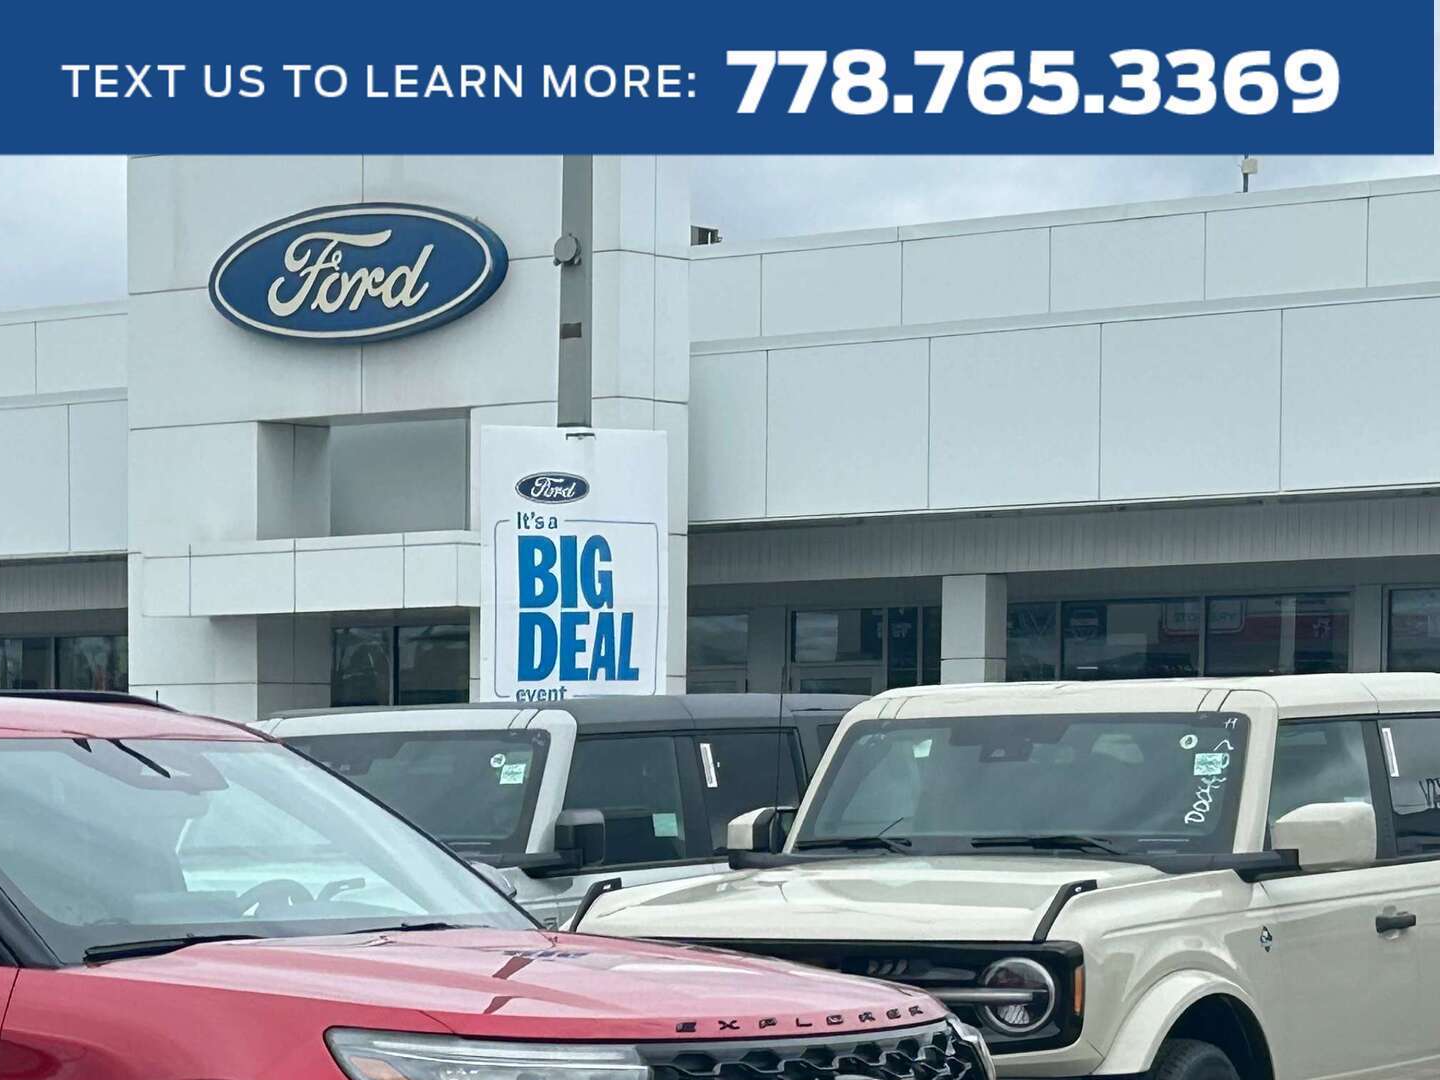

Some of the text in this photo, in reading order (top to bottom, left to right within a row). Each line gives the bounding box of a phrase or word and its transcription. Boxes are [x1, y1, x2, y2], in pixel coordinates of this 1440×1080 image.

[267, 229, 434, 316] Ford
[531, 477, 576, 498] Ford
[517, 512, 558, 530] It's a
[518, 535, 614, 609] BIG
[518, 612, 640, 681] DEAL
[516, 686, 567, 703] event
[675, 1005, 924, 1033] EXPLORER
